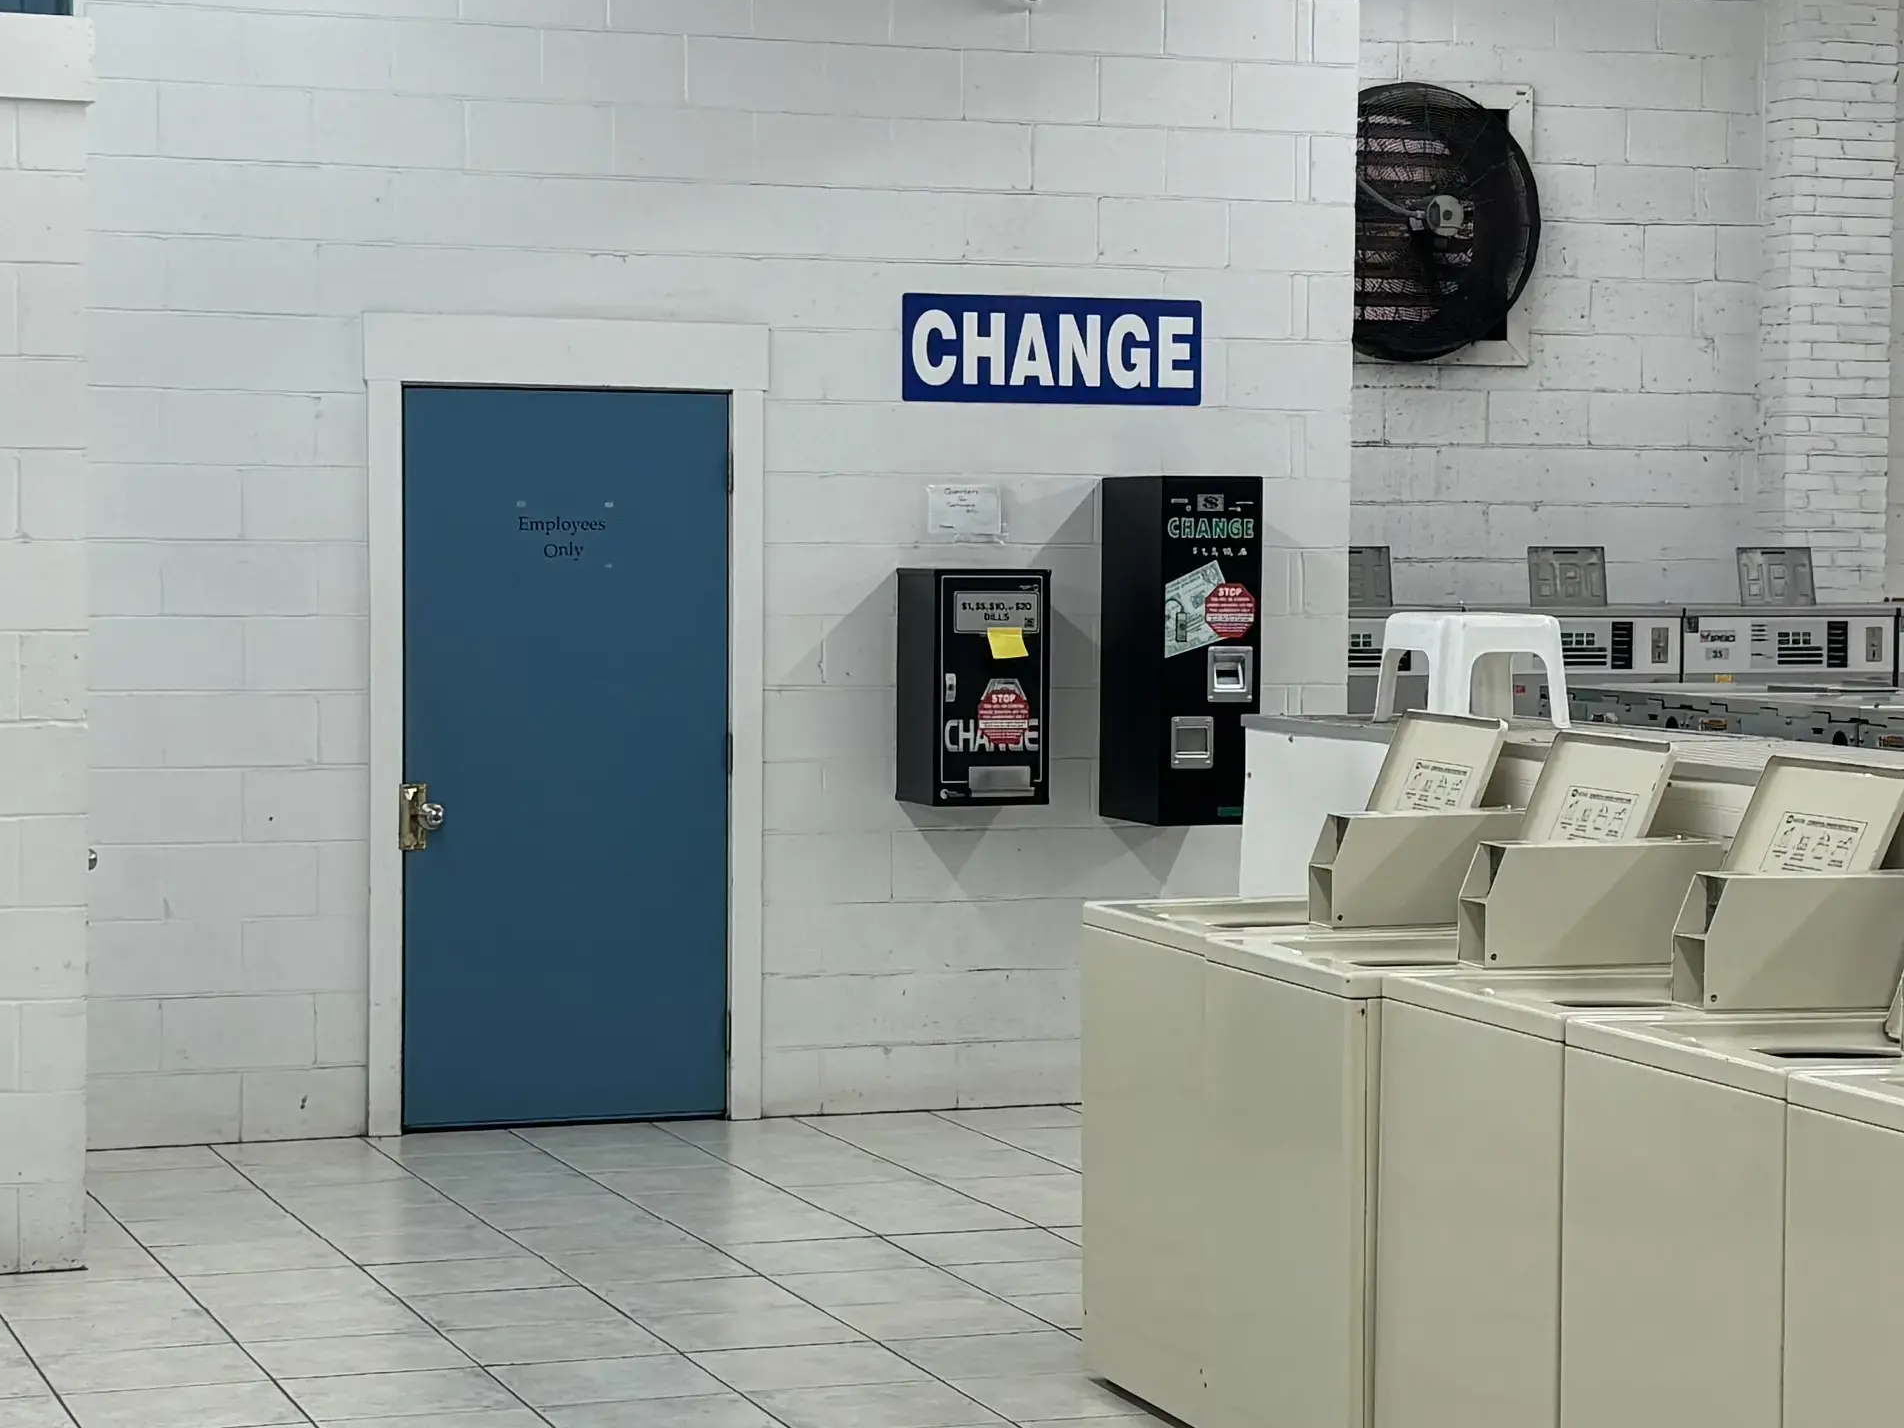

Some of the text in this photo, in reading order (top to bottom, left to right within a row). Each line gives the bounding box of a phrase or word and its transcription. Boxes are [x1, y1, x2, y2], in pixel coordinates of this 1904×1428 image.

[912, 309, 1194, 389] CHANGE
[518, 515, 606, 536] Employees
[1167, 517, 1254, 539] CHANGE
[543, 541, 584, 561] Only
[1218, 587, 1243, 597] STOP
[991, 693, 1017, 704] STOP
[945, 718, 1039, 752] CHAE
